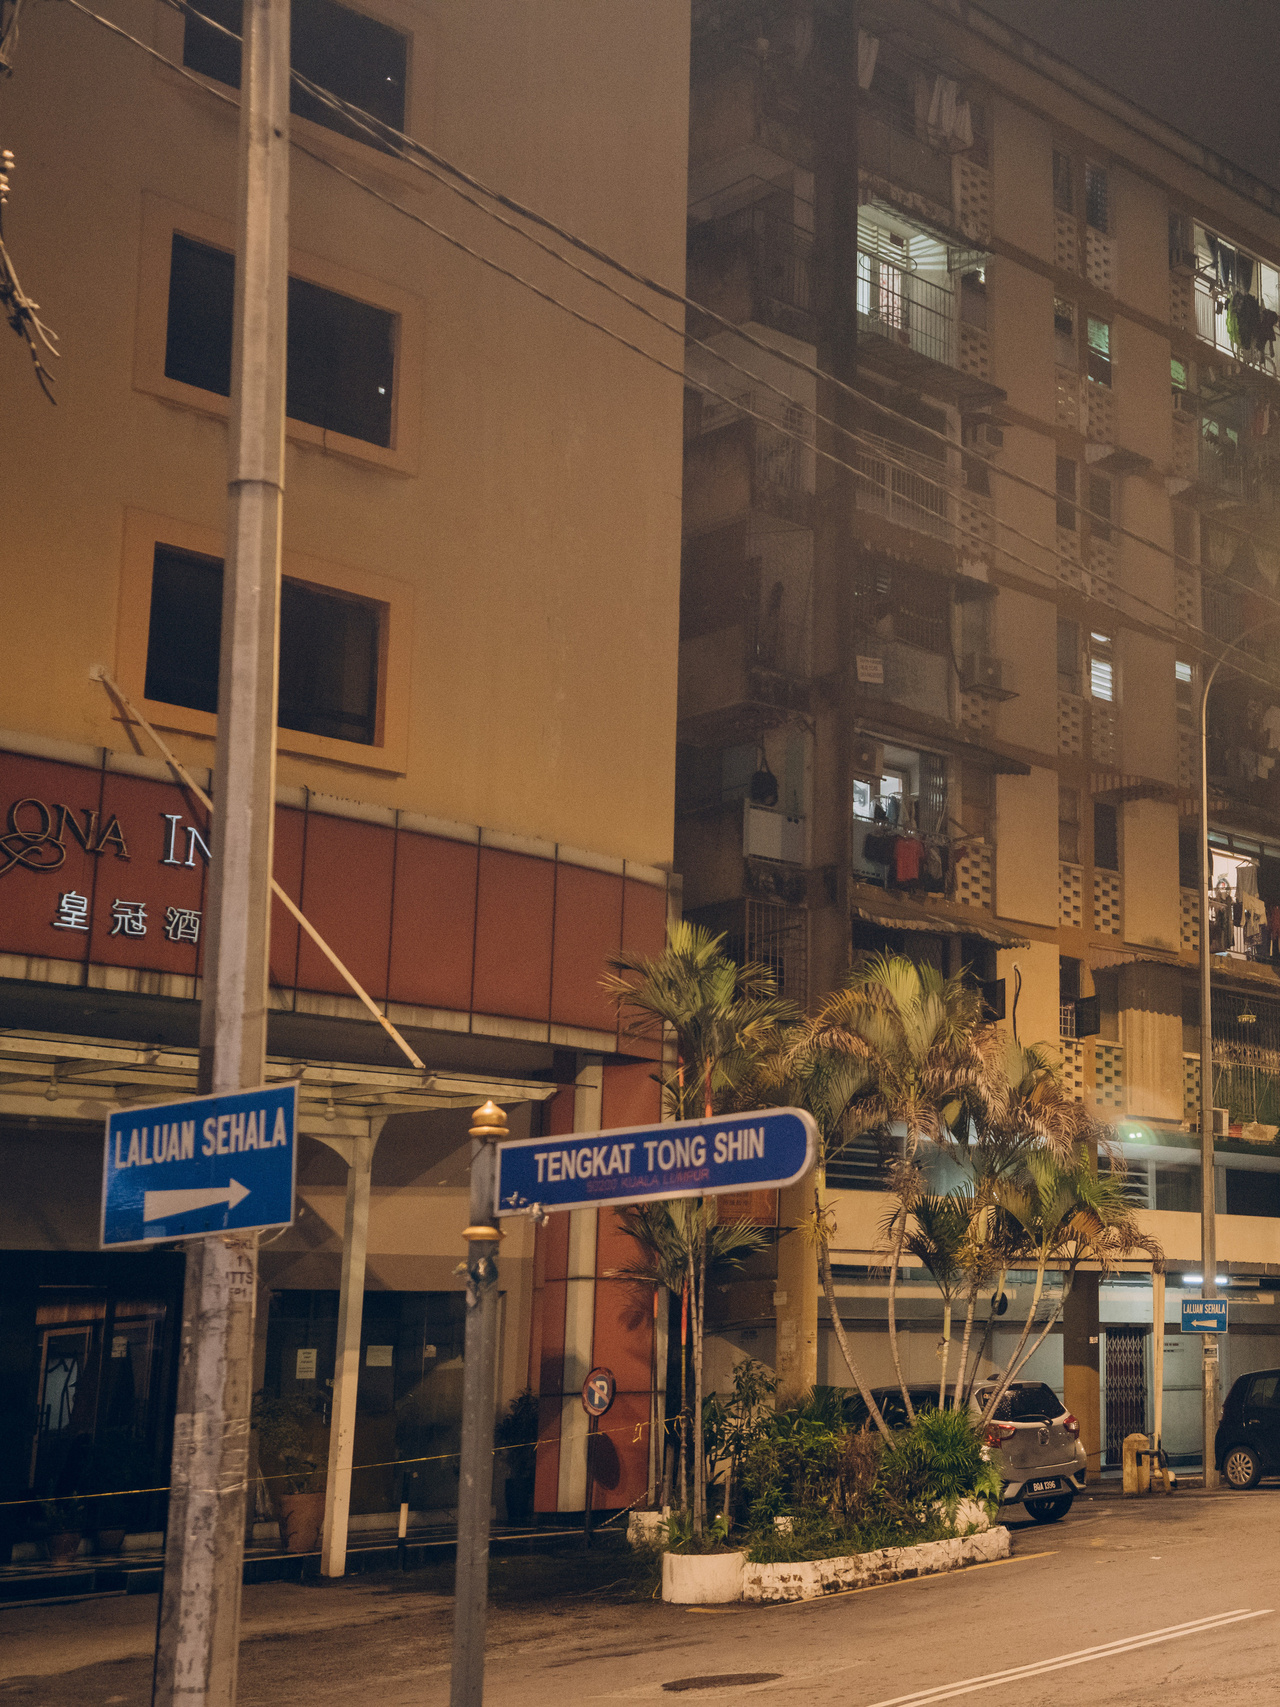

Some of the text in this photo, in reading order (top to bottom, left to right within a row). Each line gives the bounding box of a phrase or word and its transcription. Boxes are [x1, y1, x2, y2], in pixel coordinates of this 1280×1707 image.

[114, 1106, 288, 1170] LALUAN SEHALA
[534, 1126, 765, 1183] TENGKAT TONG SHIN
[621, 1174, 659, 1188] KUALA
[662, 1167, 710, 1185] LUMPUR
[1183, 1303, 1226, 1314] LALUAN SEHALA
